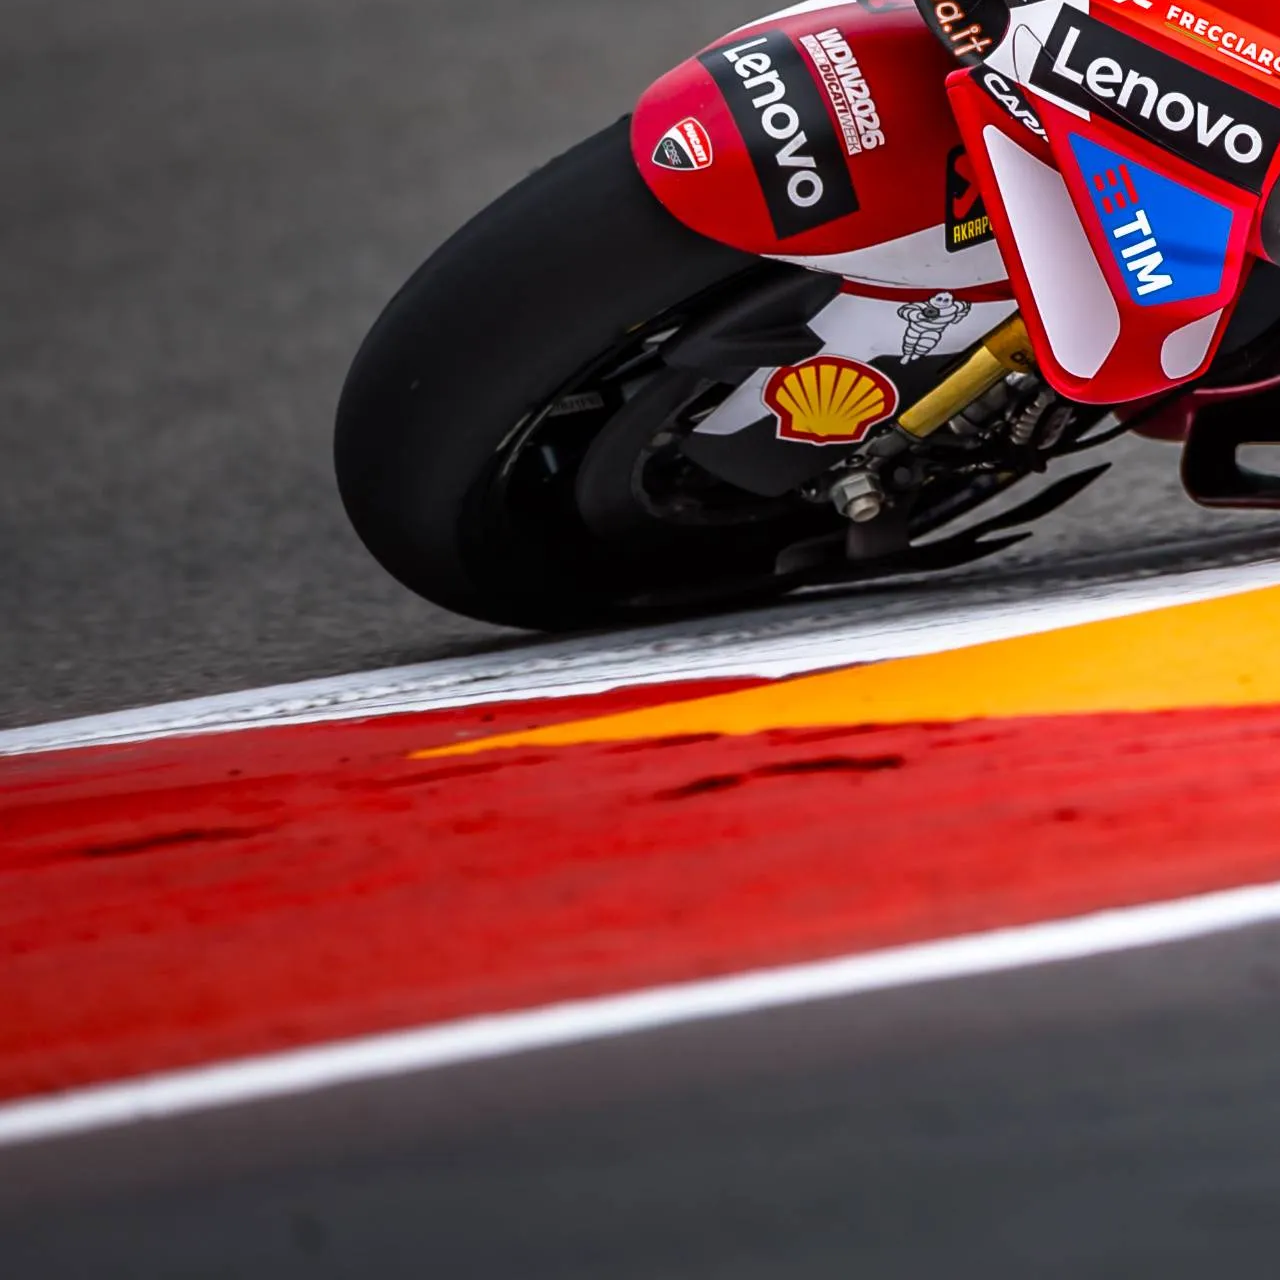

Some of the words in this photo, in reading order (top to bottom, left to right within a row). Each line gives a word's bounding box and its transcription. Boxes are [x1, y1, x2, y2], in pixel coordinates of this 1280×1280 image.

[722, 36, 824, 208] Lenovo
[814, 27, 886, 151] WDW2026
[1051, 25, 1264, 165] Lenovo
[683, 122, 709, 163] DUCATI
[953, 215, 994, 244] AKRAP
[1113, 208, 1174, 296] TIM
